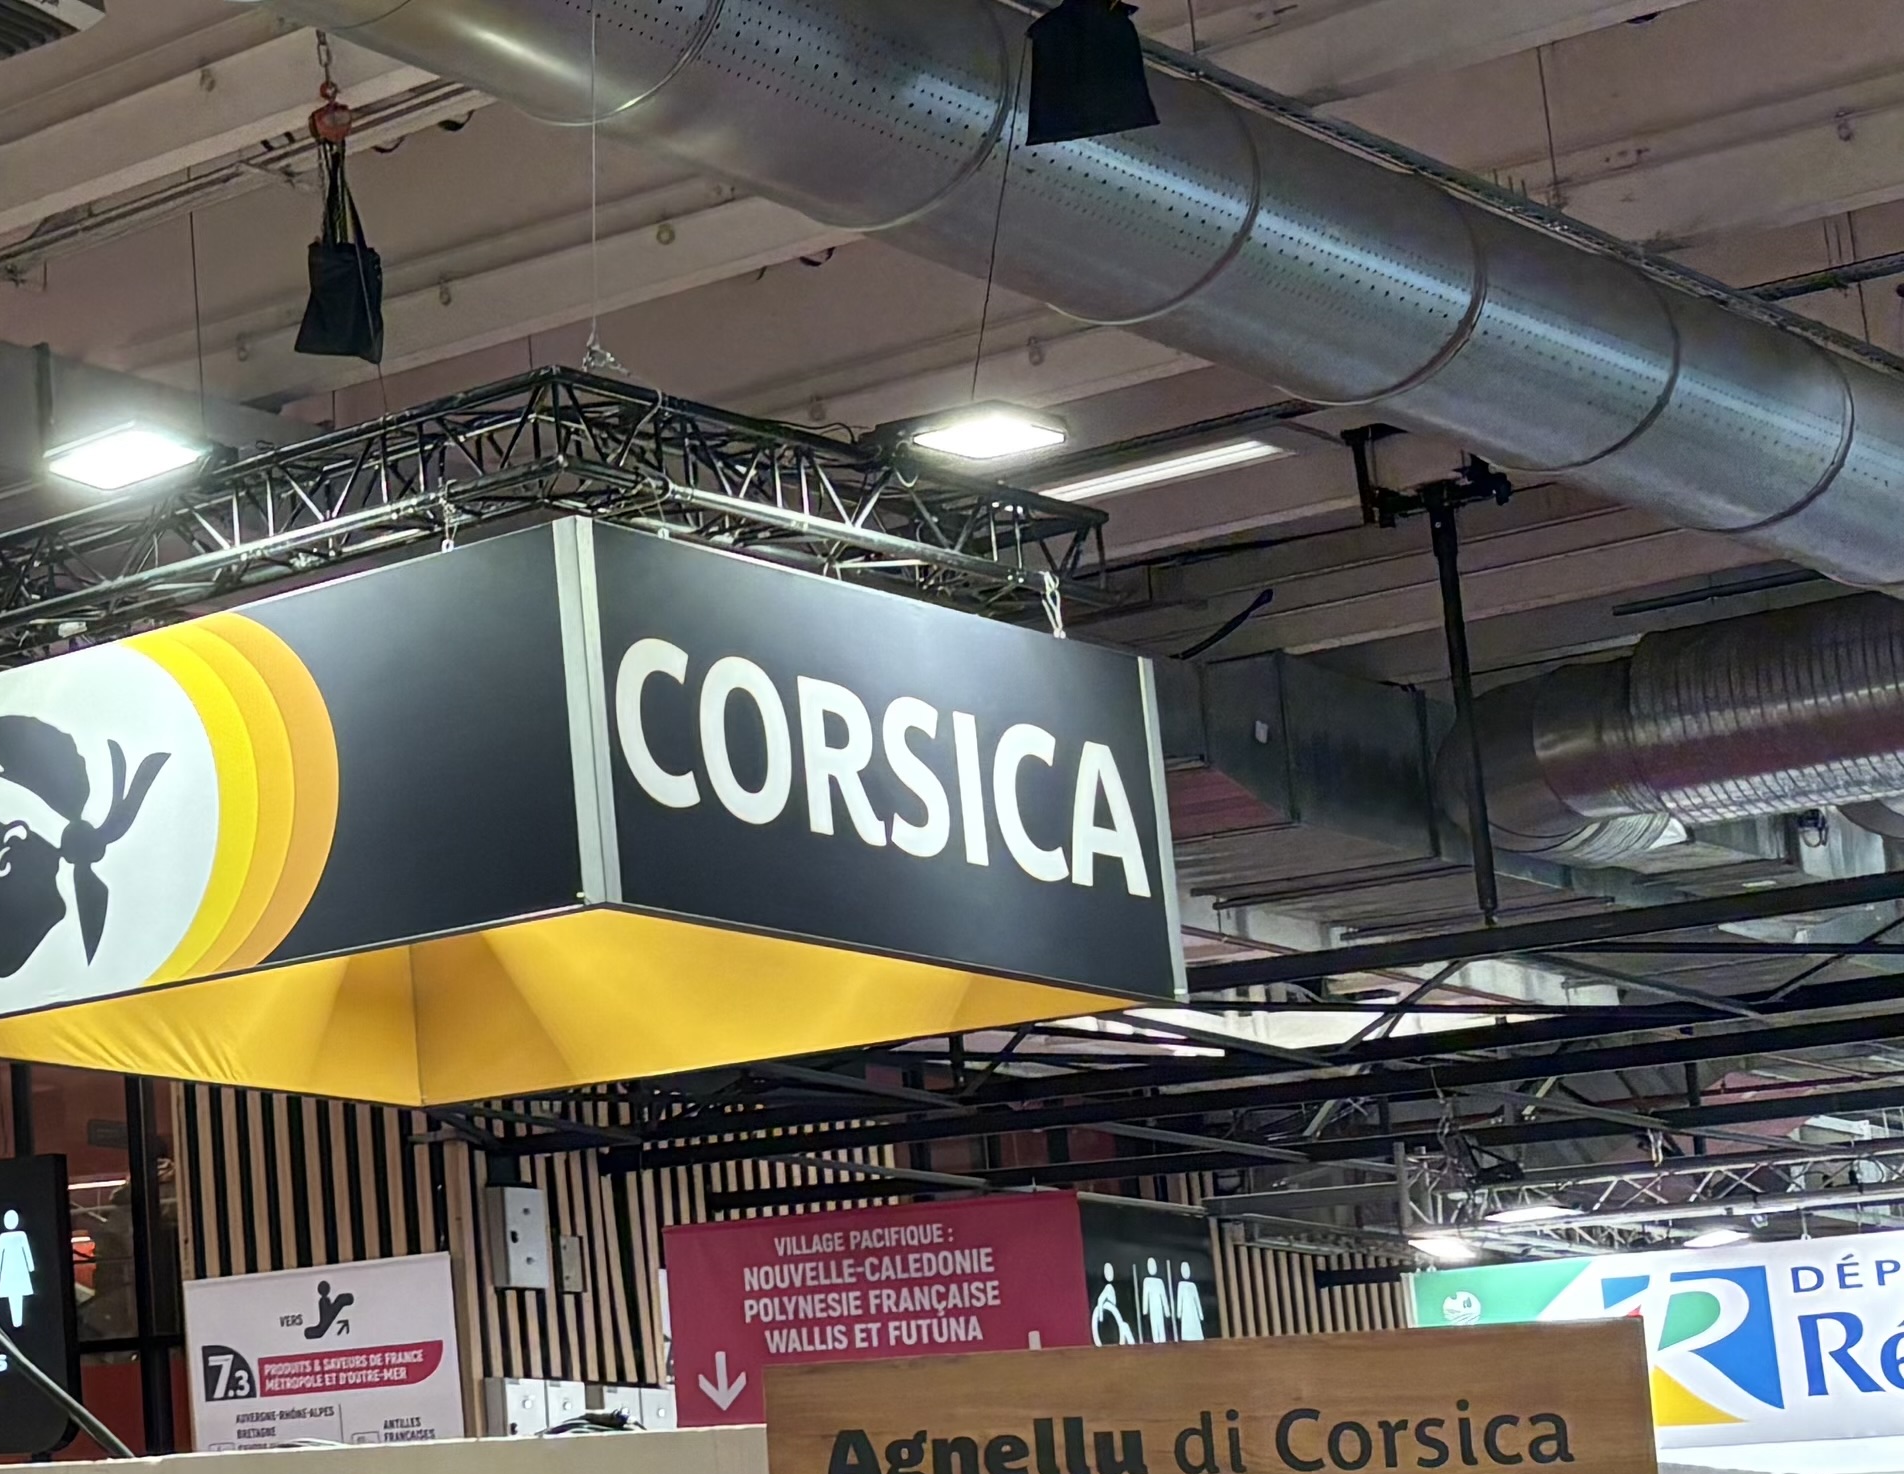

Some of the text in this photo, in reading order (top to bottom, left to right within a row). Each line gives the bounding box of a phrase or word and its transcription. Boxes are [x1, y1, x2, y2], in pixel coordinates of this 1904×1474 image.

[615, 637, 1150, 897] CORSICA
[774, 1232, 845, 1257] VILLAGE
[849, 1223, 944, 1250] PACIFIQUE
[743, 1248, 995, 1291] NOUVELLE-CALEDONIE
[1791, 1253, 1901, 1293] DÉP
[279, 1313, 303, 1328] VERS
[743, 1280, 1001, 1324] POLYNESIE FRANÇAISE
[765, 1315, 984, 1354] WALLIS ET FUTUNA
[208, 1354, 251, 1400] 7.3
[264, 1361, 313, 1376] PRODUITS
[323, 1355, 368, 1370] SAVEURS
[368, 1353, 383, 1367] DE
[385, 1349, 424, 1364] FRANCE
[265, 1368, 407, 1392] MÉTROPOLE ET D'OUTRE-MER
[384, 1417, 422, 1431] ANTILLES
[1276, 1398, 1575, 1472] Corsica
